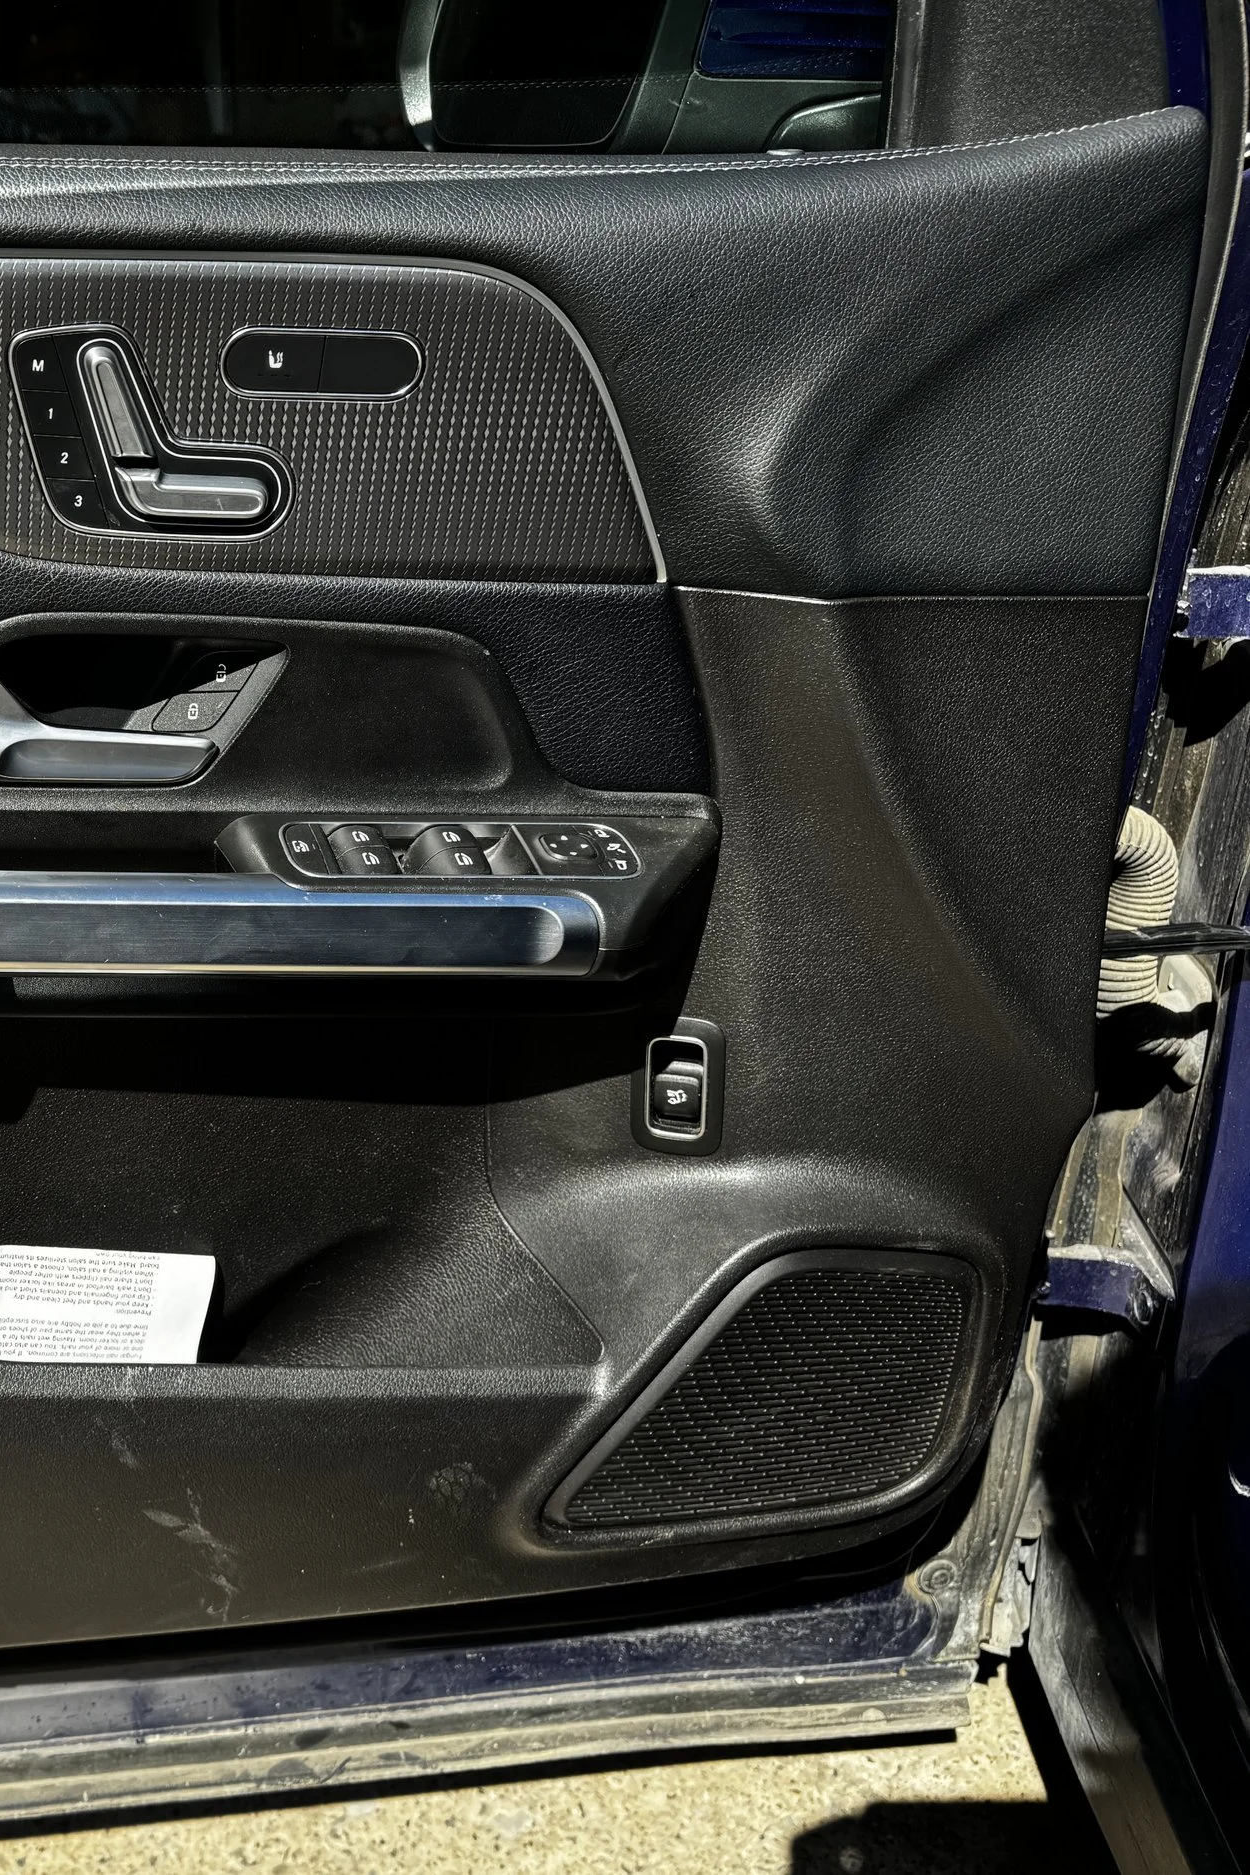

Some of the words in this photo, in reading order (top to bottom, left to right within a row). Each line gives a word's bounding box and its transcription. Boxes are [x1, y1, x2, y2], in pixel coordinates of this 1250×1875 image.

[32, 359, 45, 372] M
[48, 407, 54, 420] 1
[60, 452, 69, 464] 2
[73, 495, 83, 507] 3
